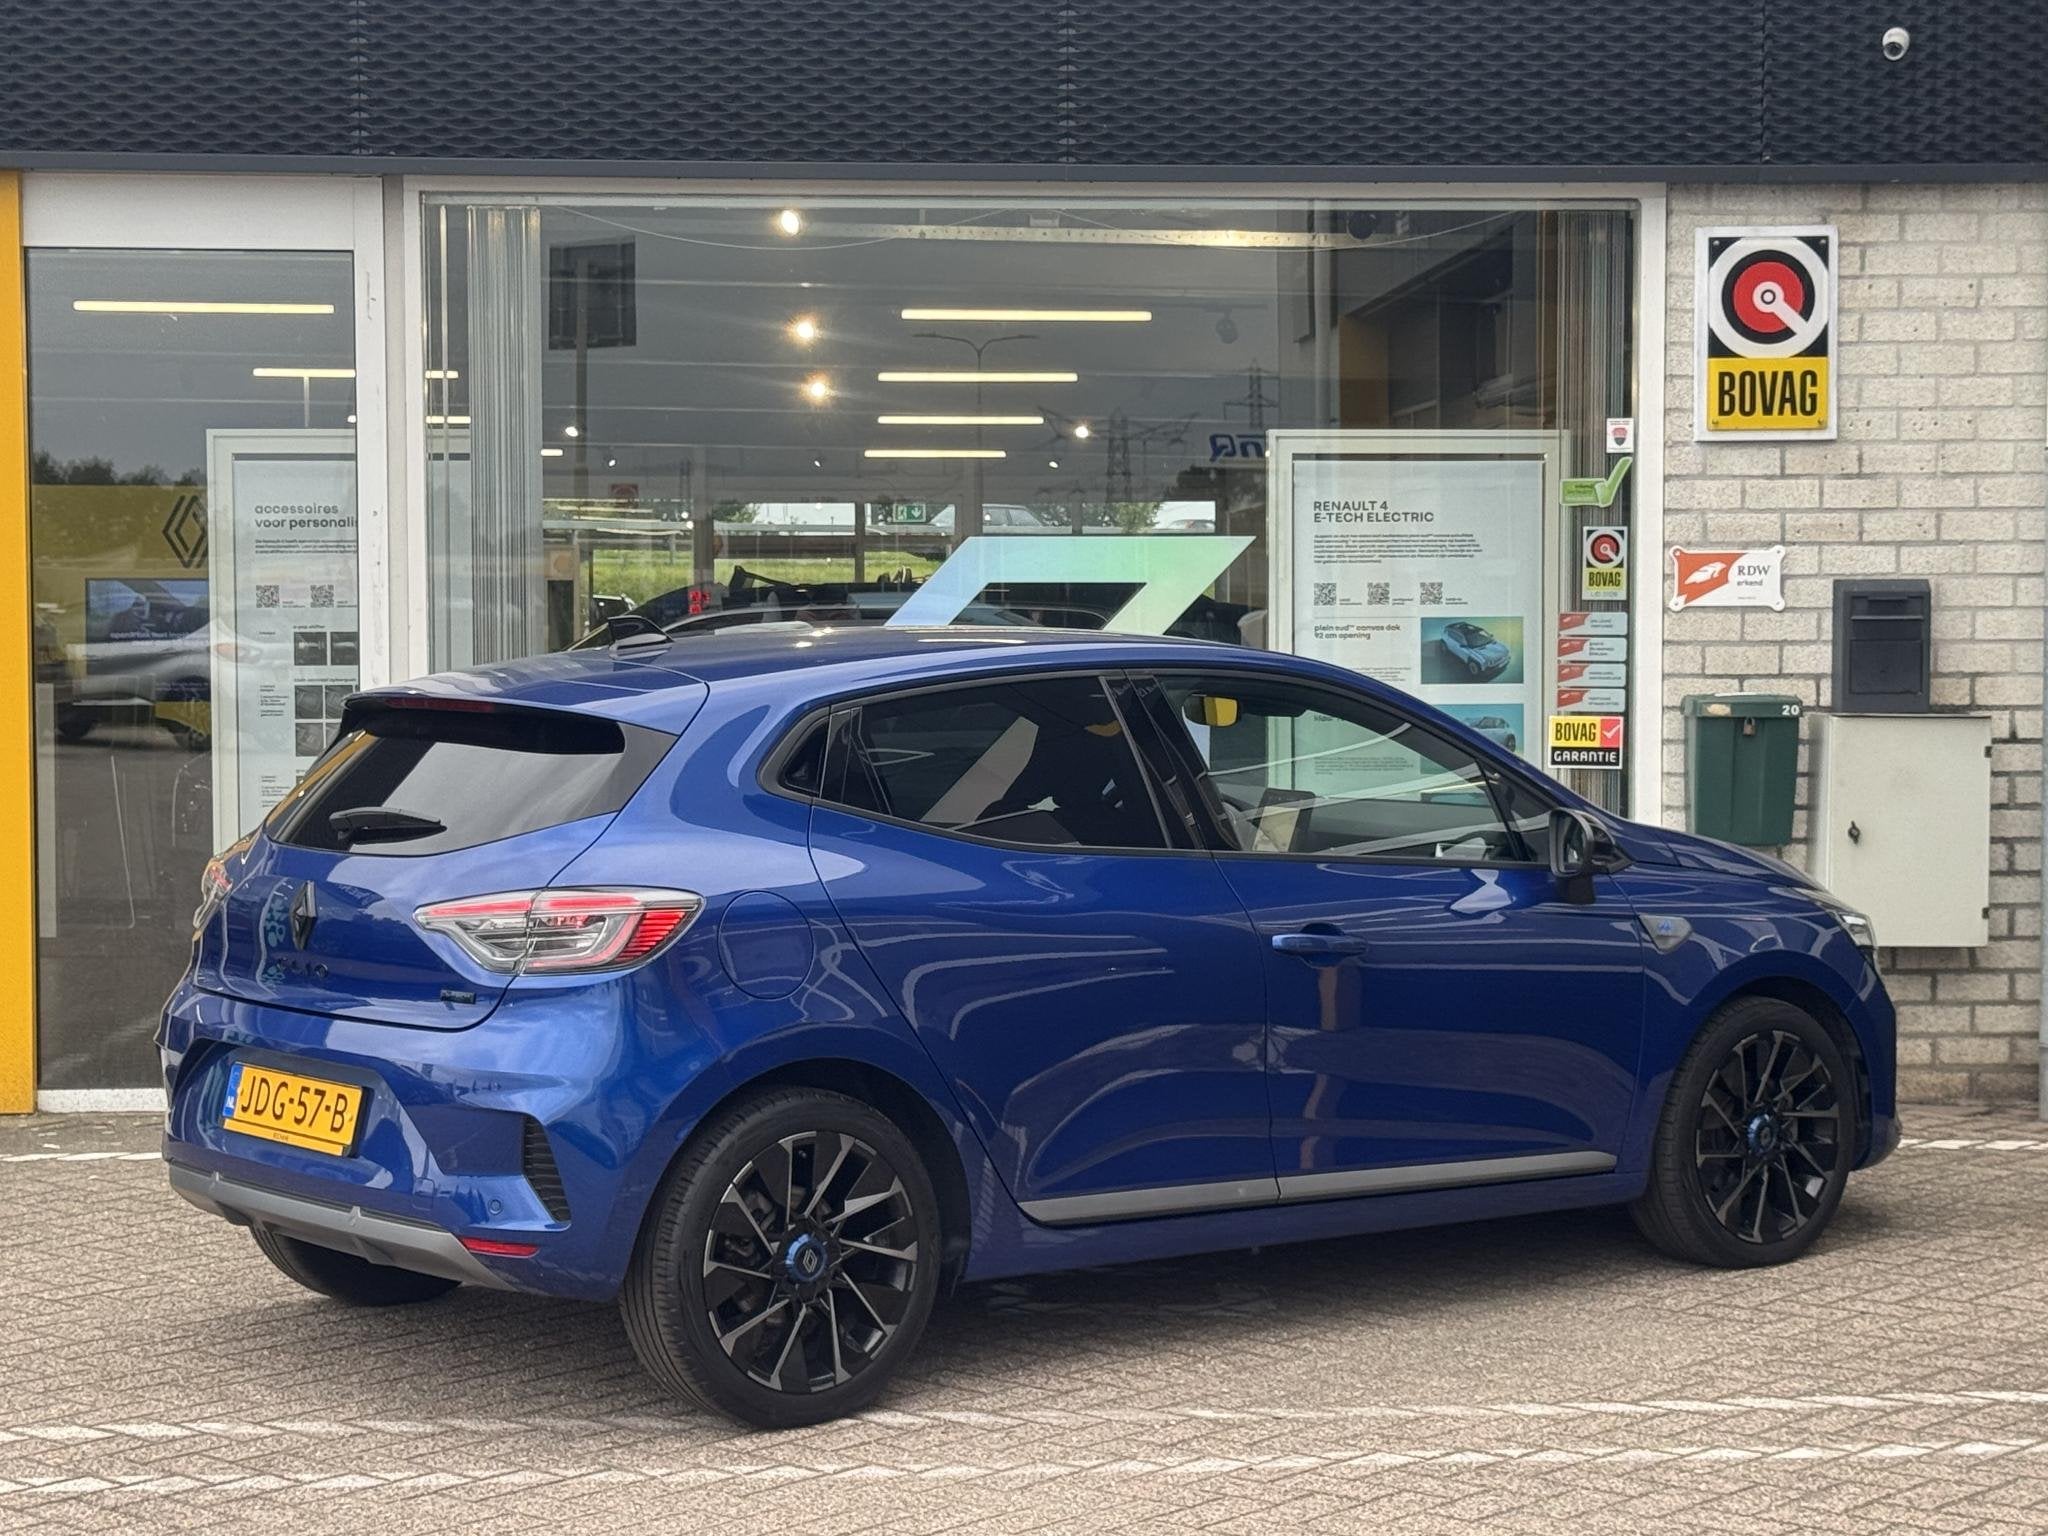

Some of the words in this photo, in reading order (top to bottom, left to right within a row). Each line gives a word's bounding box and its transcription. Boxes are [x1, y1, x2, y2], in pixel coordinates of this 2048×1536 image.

[1718, 370, 1818, 417] BOVAG
[254, 502, 339, 514] accessoires
[1313, 501, 1377, 511] RENAULT
[1379, 501, 1388, 511] 4
[254, 518, 286, 528] voor
[1313, 512, 1364, 523] E-TECH
[1366, 512, 1434, 523] ELECTRIC
[1737, 565, 1771, 576] RDW
[1588, 571, 1621, 588] BOVAG
[1782, 705, 1800, 716] 20
[1555, 722, 1597, 742] BOVAG
[1553, 750, 1618, 763] GARANTIE
[240, 1075, 349, 1134] JDG-57-B
